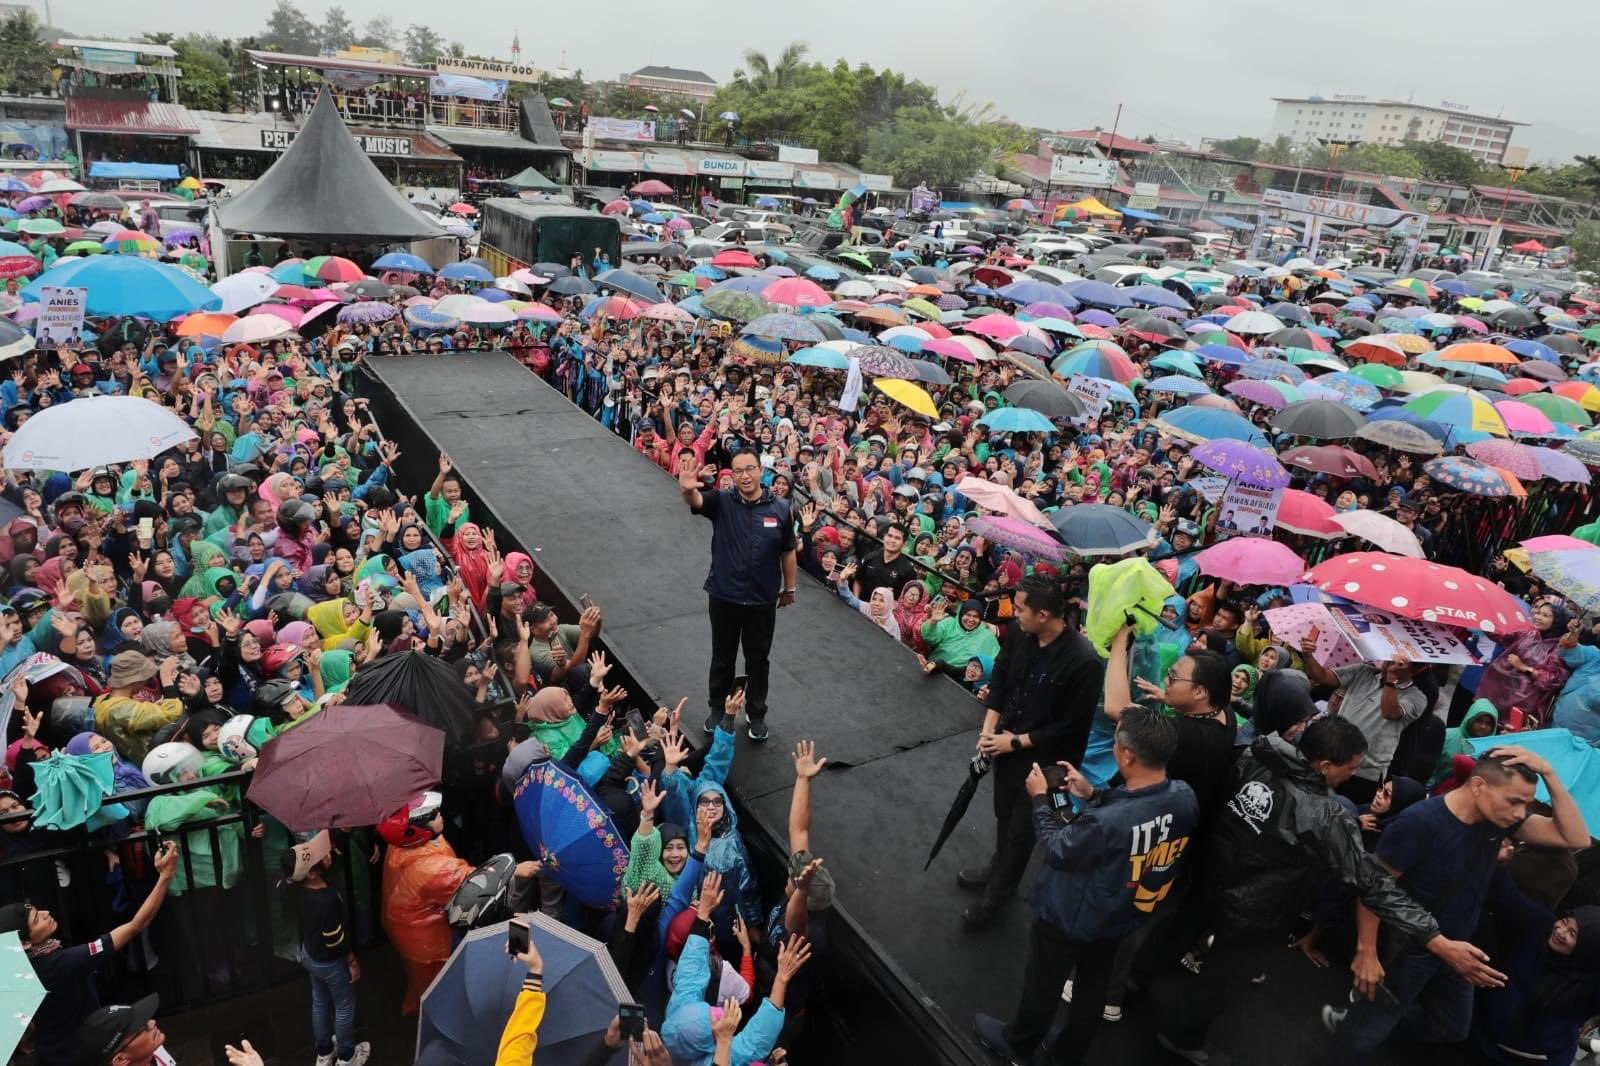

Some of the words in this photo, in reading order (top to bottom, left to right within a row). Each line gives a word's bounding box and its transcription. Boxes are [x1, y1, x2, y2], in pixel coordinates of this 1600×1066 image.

[438, 57, 503, 73] NUSANTARA
[505, 65, 533, 75] FOOD
[264, 131, 295, 148] PEL
[366, 136, 409, 154] MUSIC
[703, 160, 738, 171] BUNDA
[1307, 197, 1373, 222] START
[49, 298, 79, 306] ANIES
[1076, 384, 1101, 399] ANIES
[1227, 495, 1250, 507] IRWAN
[1250, 499, 1277, 511] AFRIADI
[1435, 606, 1478, 621] STAR
[1411, 619, 1450, 655] RWAN
[1130, 813, 1173, 856] IT'S
